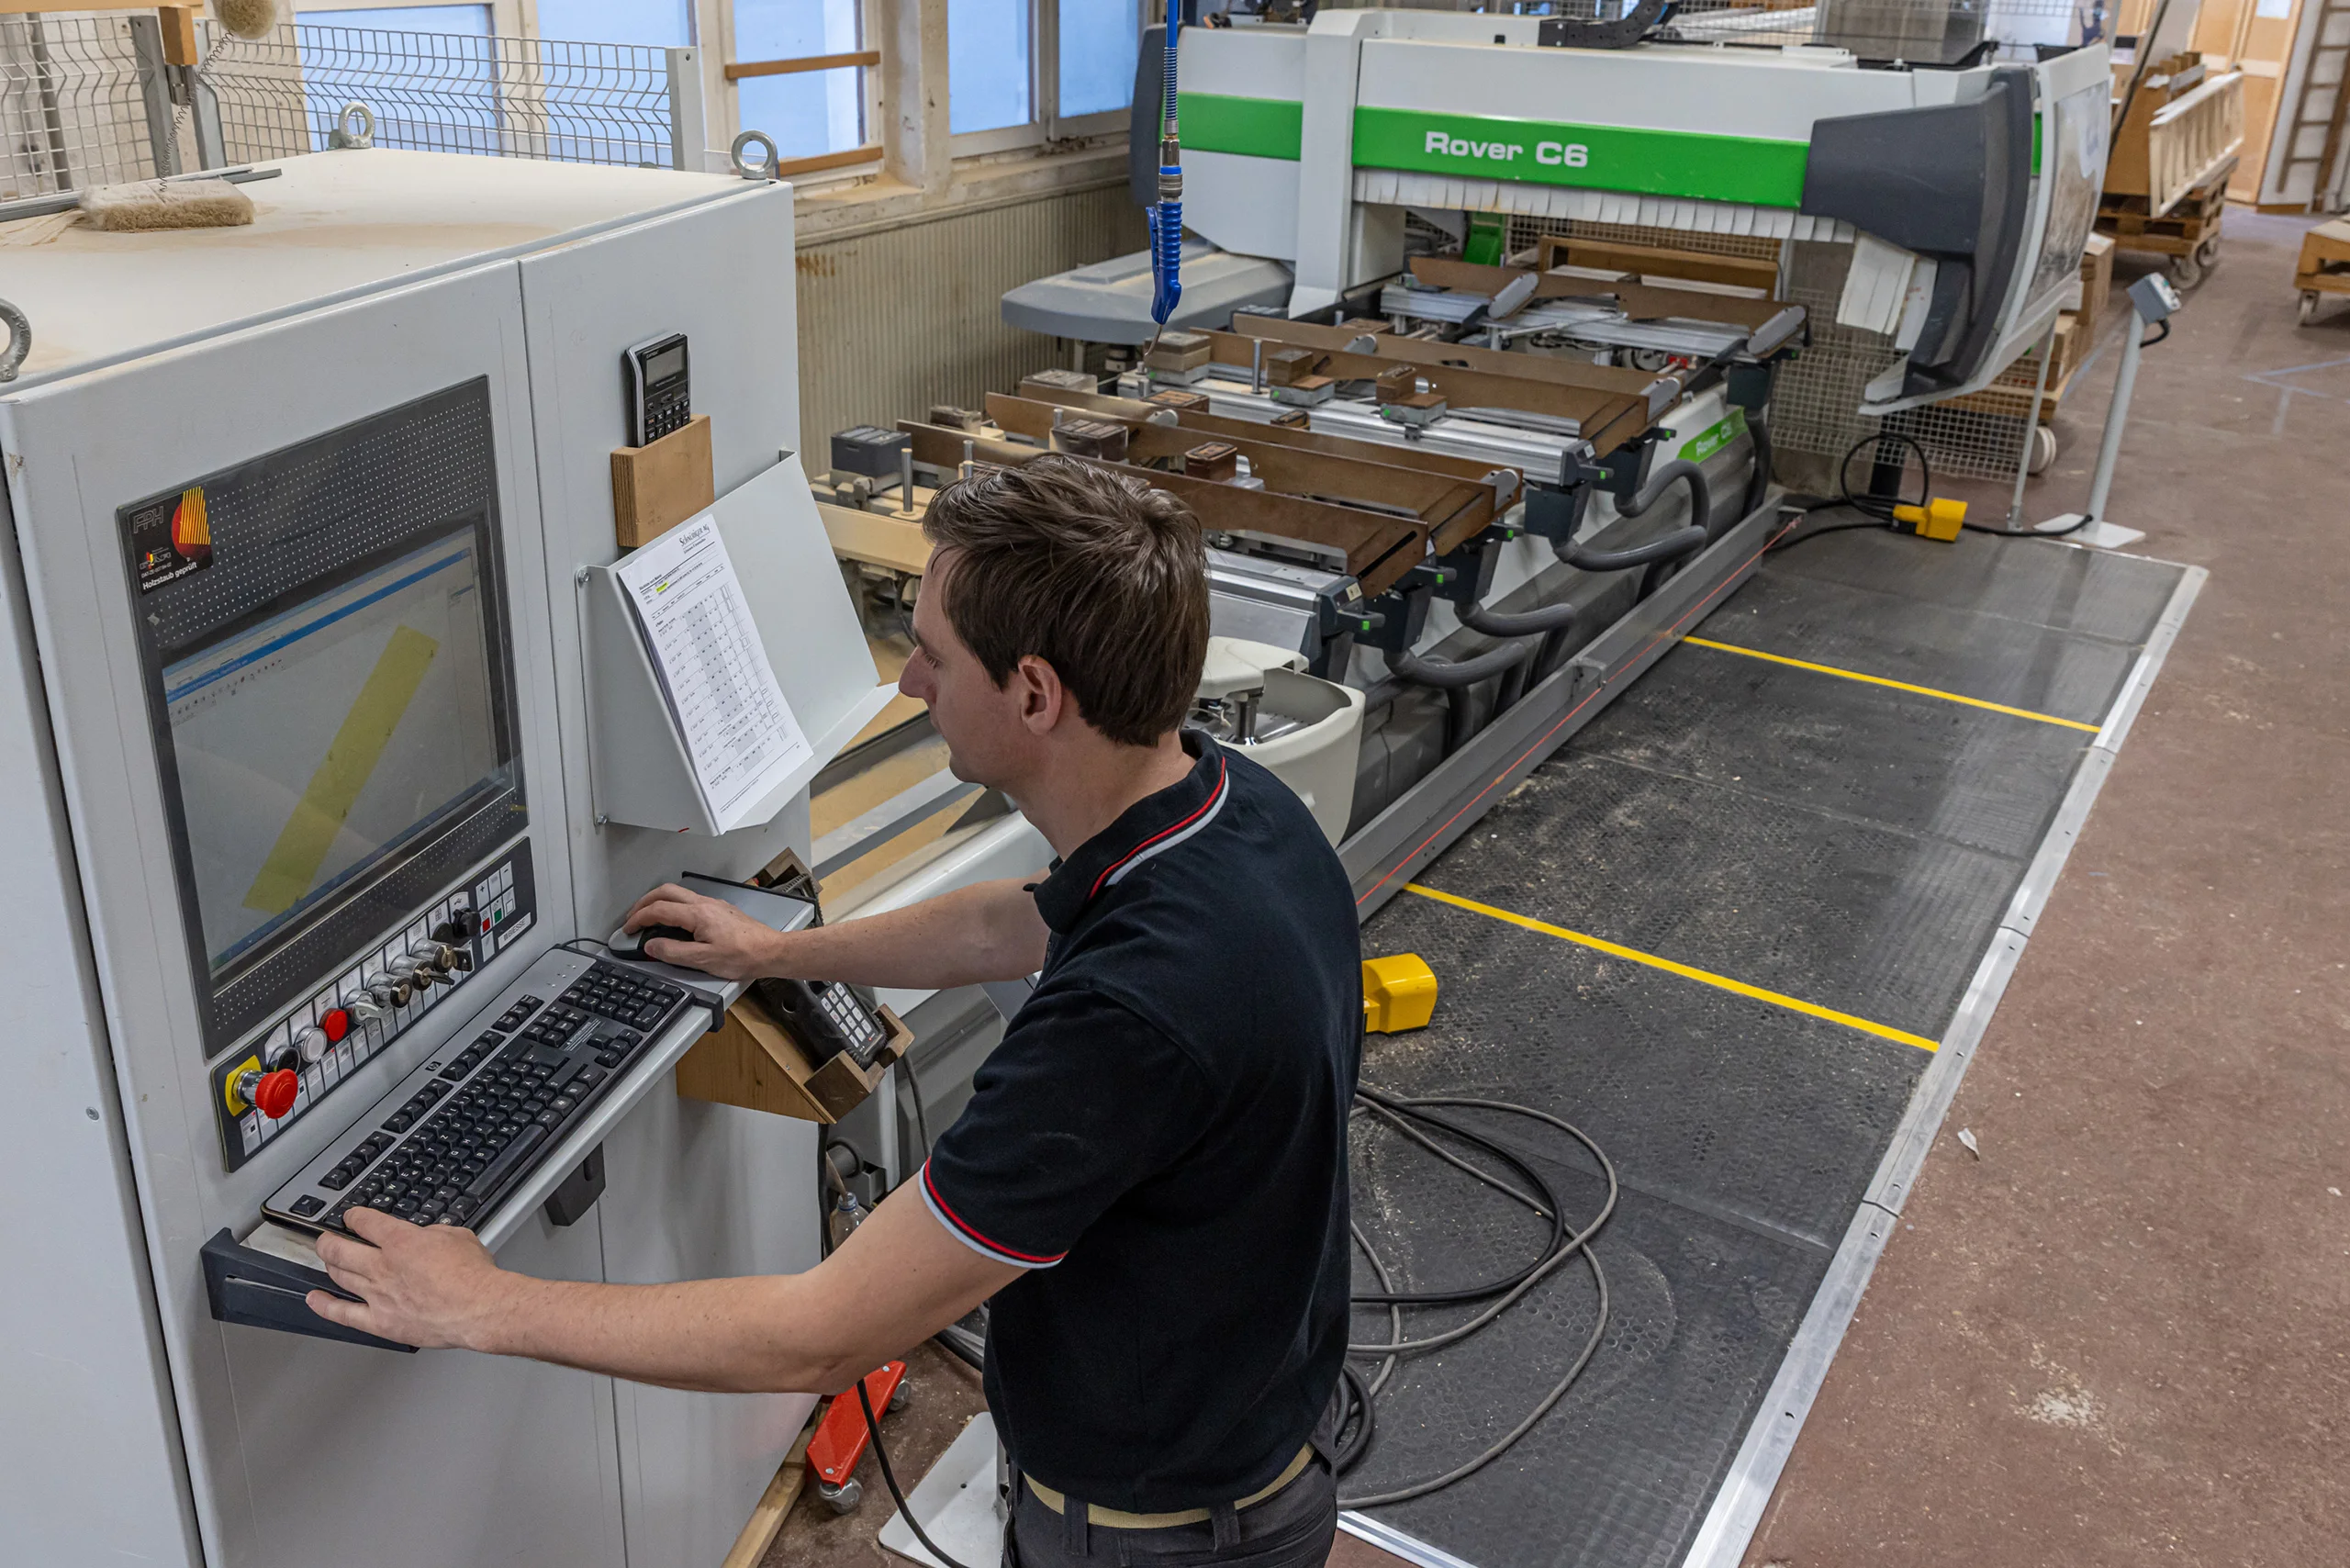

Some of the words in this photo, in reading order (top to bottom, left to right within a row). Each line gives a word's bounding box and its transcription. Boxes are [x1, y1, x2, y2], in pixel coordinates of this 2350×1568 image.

[1425, 130, 1524, 162] Rover
[1535, 141, 1589, 168] C6
[142, 571, 175, 590] Holzstaub
[174, 561, 197, 579] geprüft
